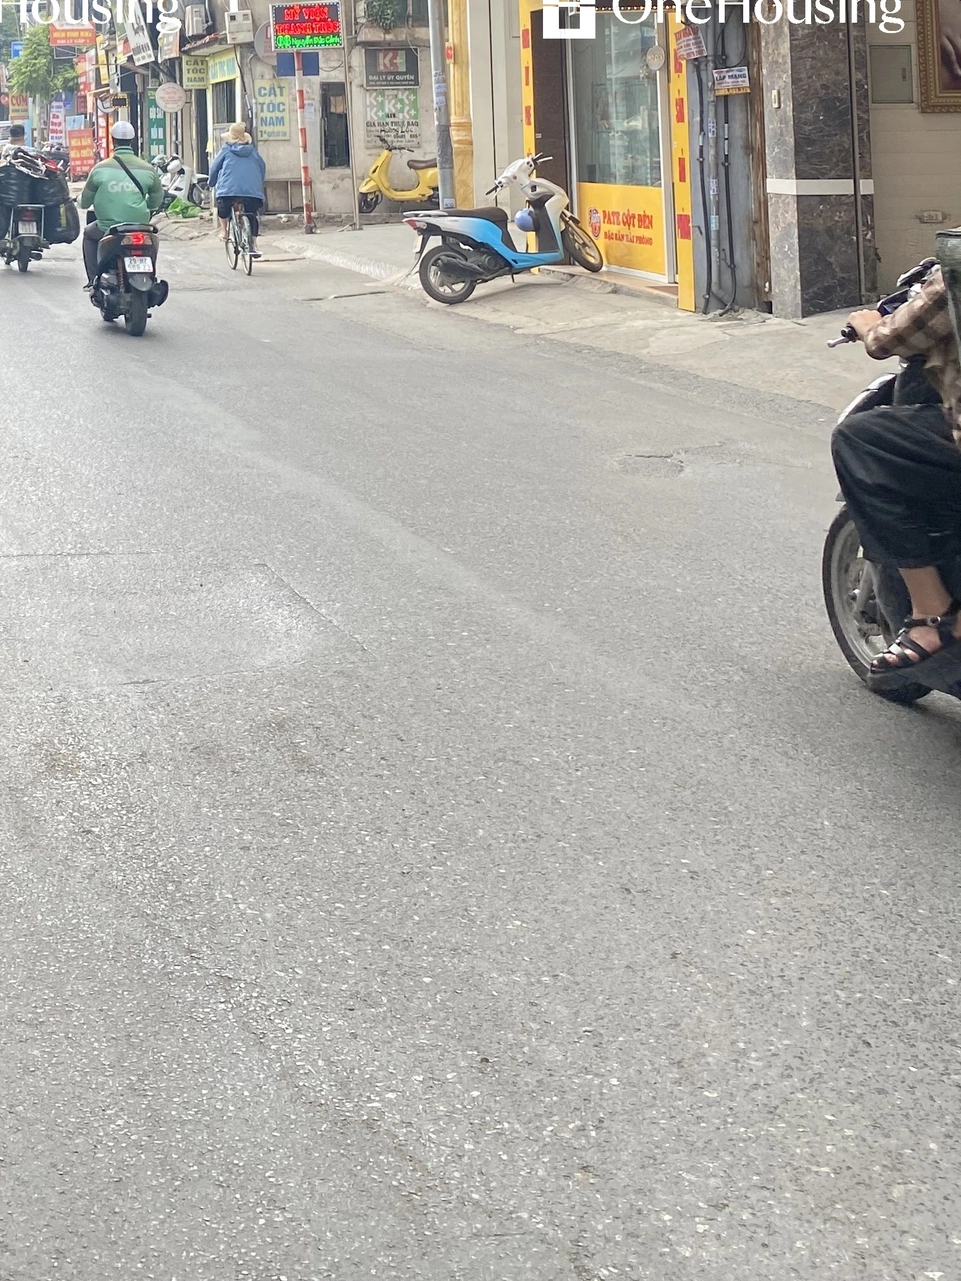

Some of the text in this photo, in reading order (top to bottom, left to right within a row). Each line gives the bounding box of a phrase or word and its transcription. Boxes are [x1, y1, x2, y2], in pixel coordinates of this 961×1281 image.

[275, 22, 312, 35] THANH
[378, 52, 403, 70] K+
[185, 66, 205, 74] TÓC
[257, 83, 286, 98] CẮT
[366, 92, 383, 106] K+
[257, 100, 286, 113] TÓC
[259, 116, 285, 127] NAM
[602, 208, 653, 230] PATE CỘT ĐÈN
